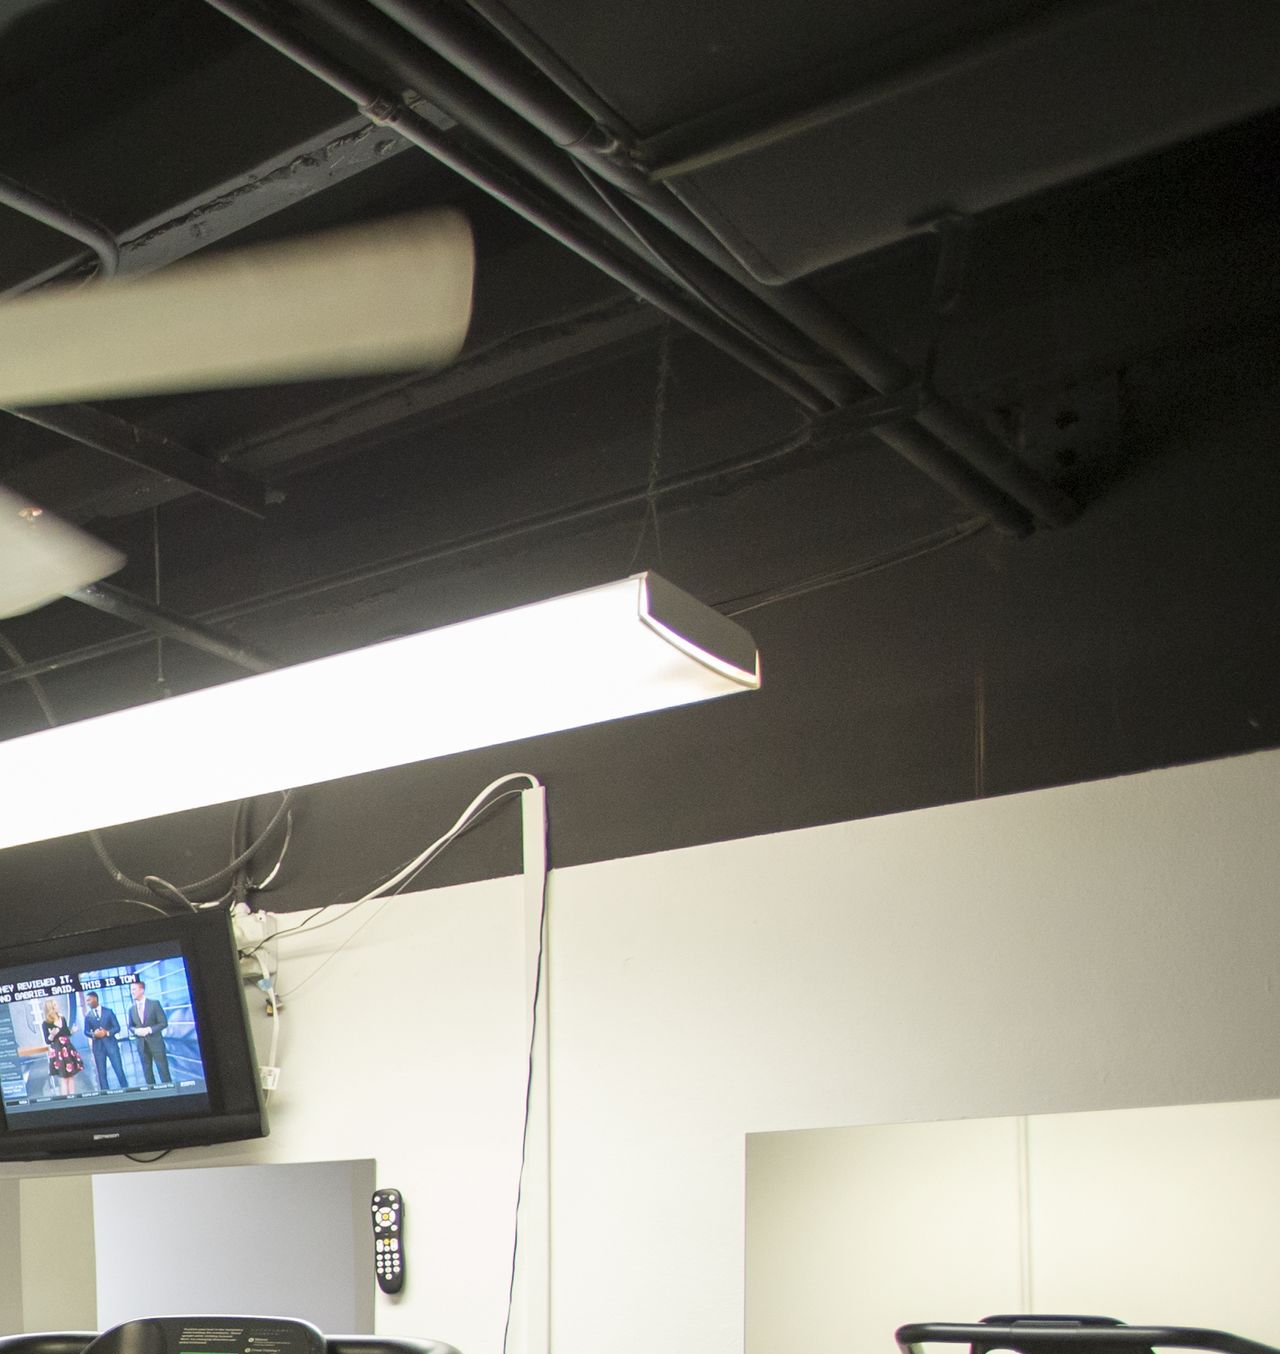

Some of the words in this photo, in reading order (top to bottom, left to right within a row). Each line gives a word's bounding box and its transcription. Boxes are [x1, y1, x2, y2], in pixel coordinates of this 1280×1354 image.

[14, 989, 49, 1001] GABRIEL
[80, 979, 102, 991] THIS
[105, 977, 117, 987] IS
[120, 974, 137, 984] TOM
[17, 977, 57, 991] REVIEWED
